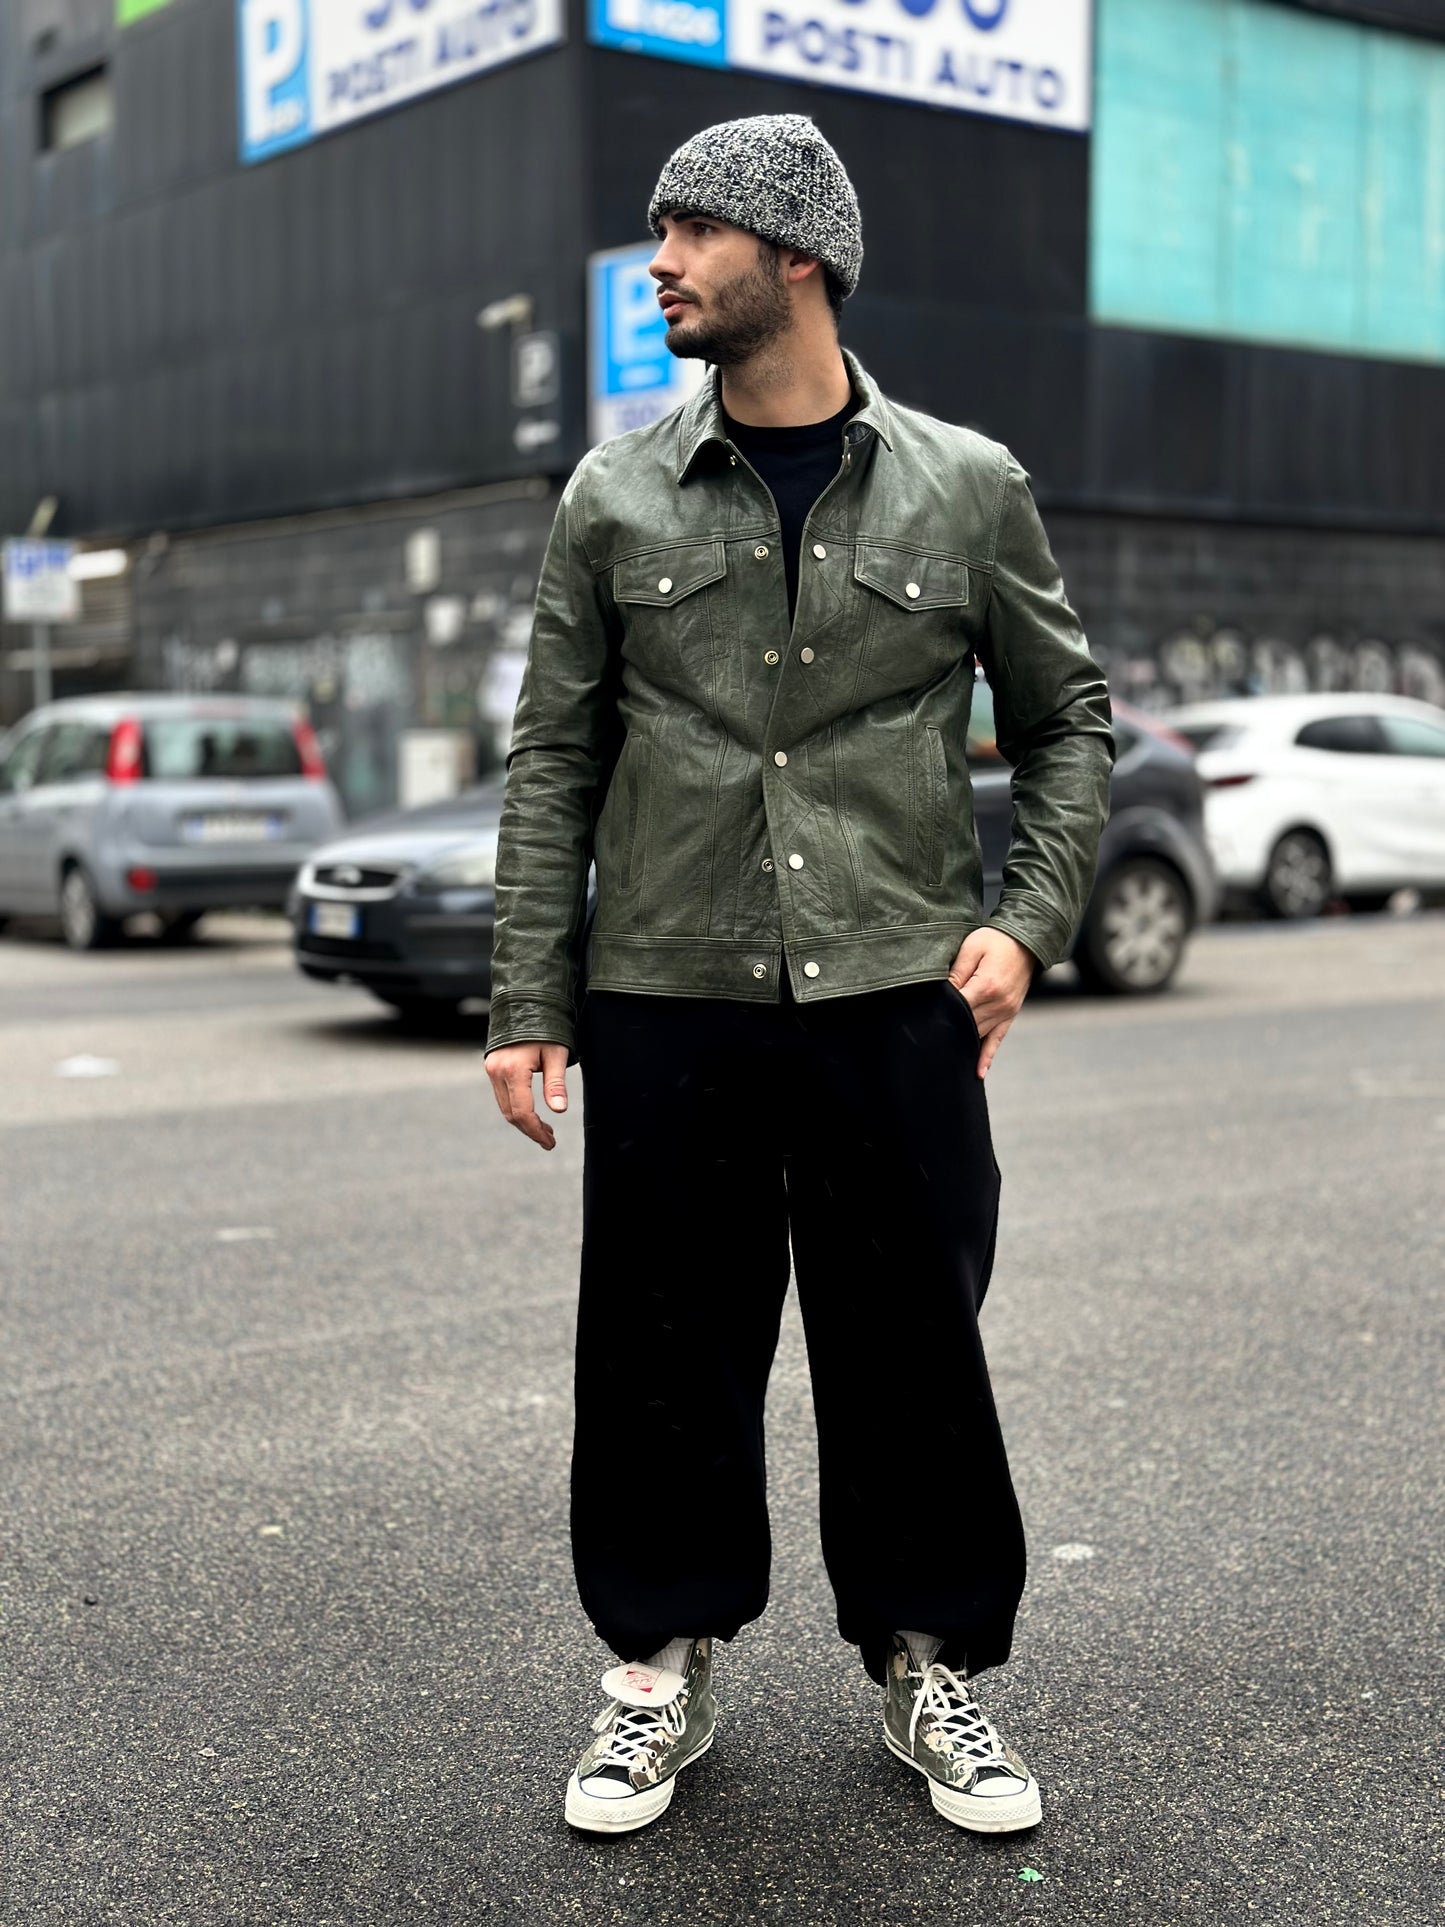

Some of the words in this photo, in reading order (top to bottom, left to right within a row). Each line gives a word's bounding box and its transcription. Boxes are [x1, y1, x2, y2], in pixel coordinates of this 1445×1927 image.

[328, 37, 423, 108] POSTI
[434, 0, 536, 66] AUTO
[764, 10, 914, 82] POSTI
[936, 47, 1064, 109] AUTO
[517, 340, 554, 400] P
